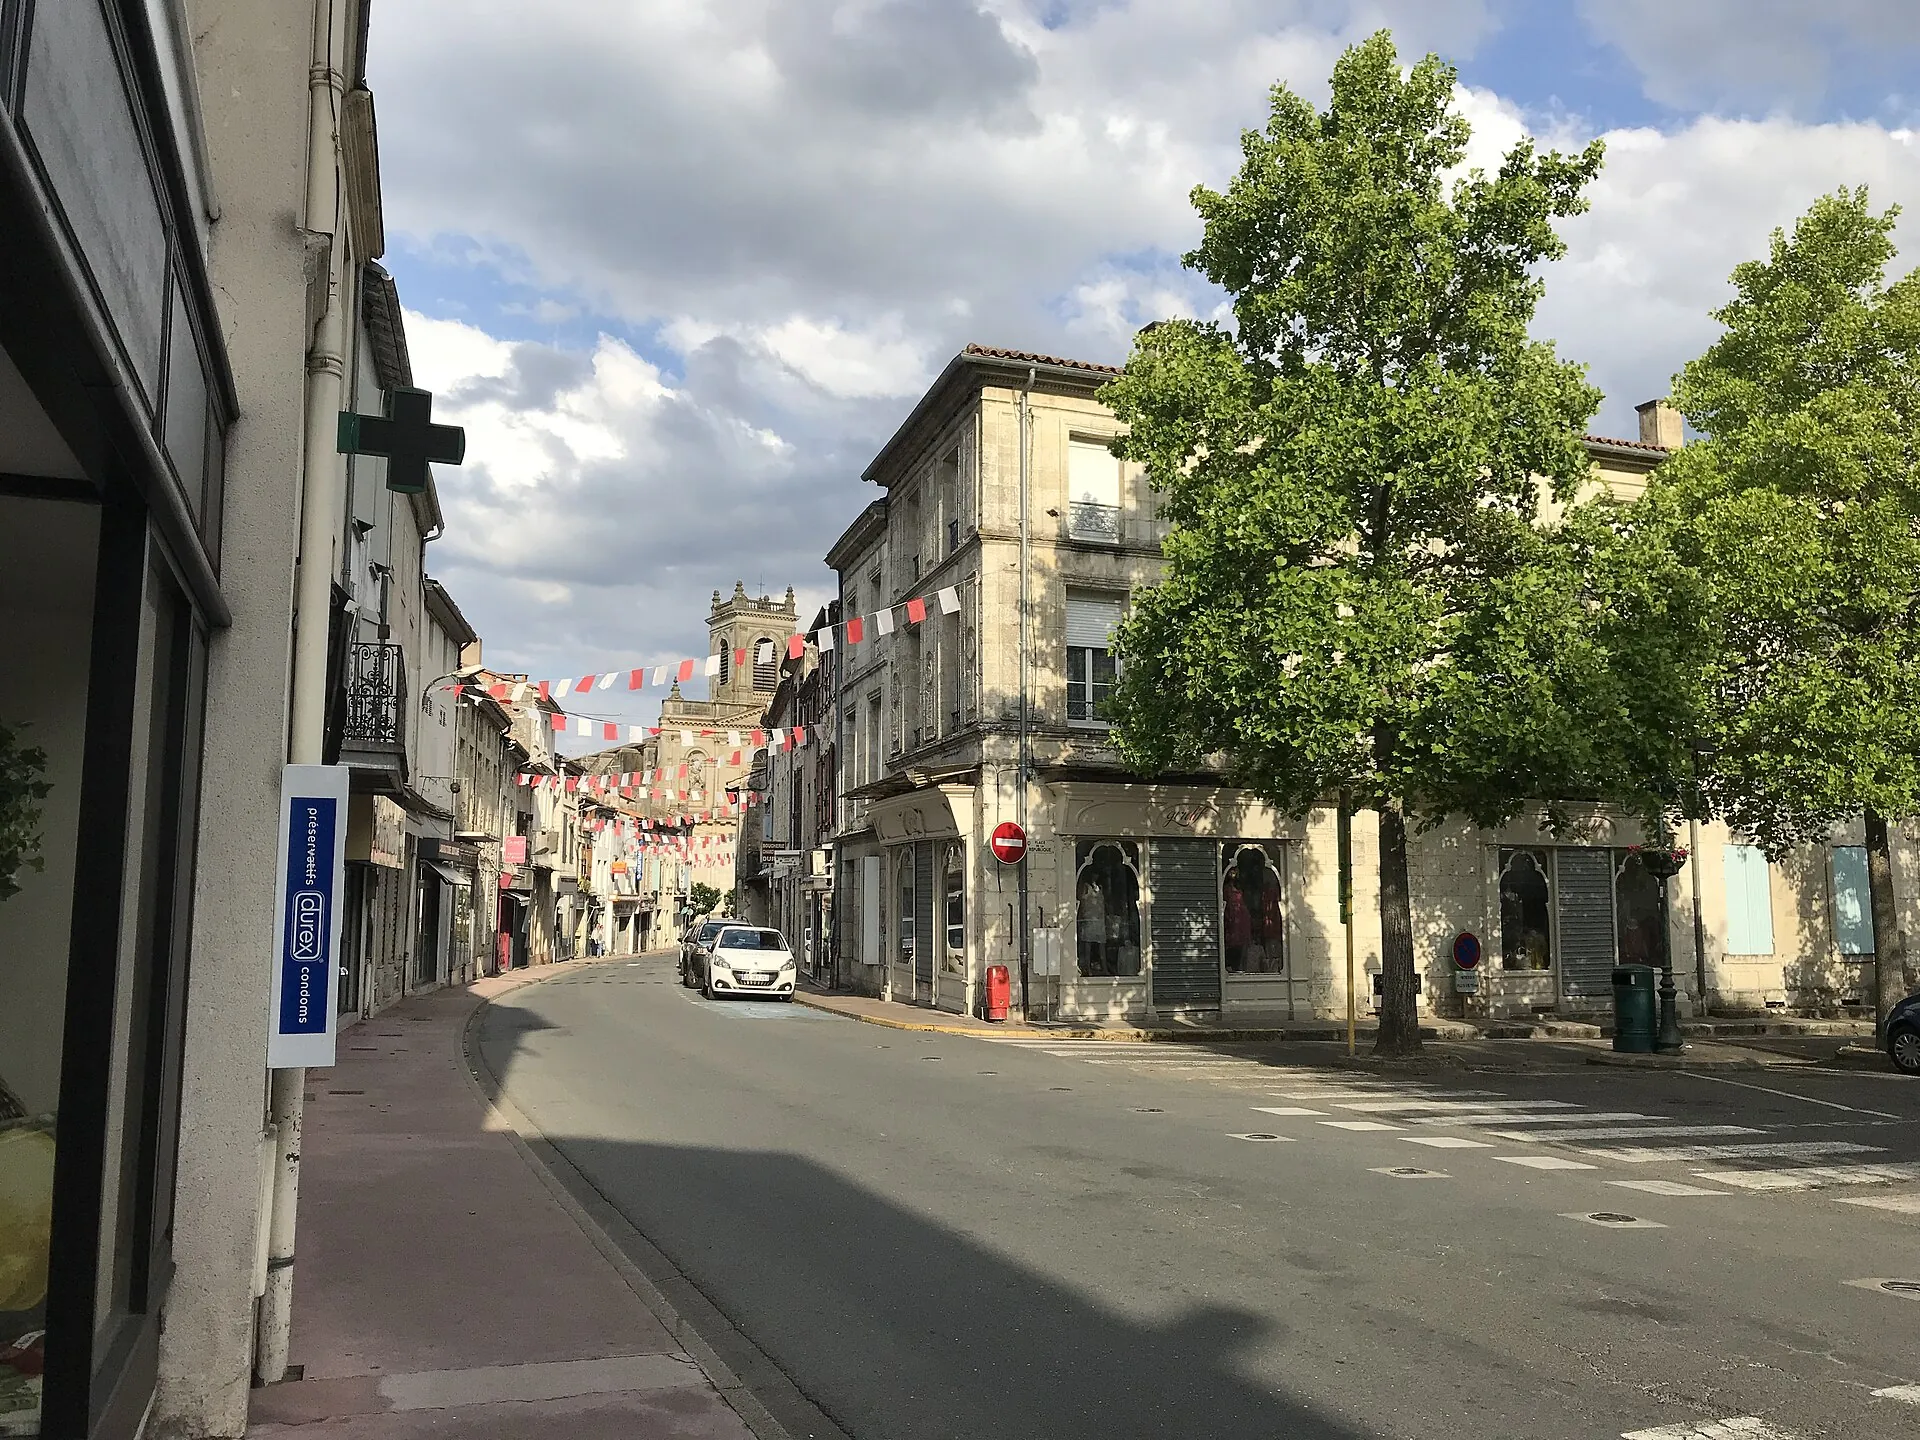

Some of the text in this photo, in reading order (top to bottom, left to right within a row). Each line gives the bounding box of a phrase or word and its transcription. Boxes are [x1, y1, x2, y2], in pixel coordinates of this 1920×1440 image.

[294, 807, 320, 1024] préservatifs durex condoms
